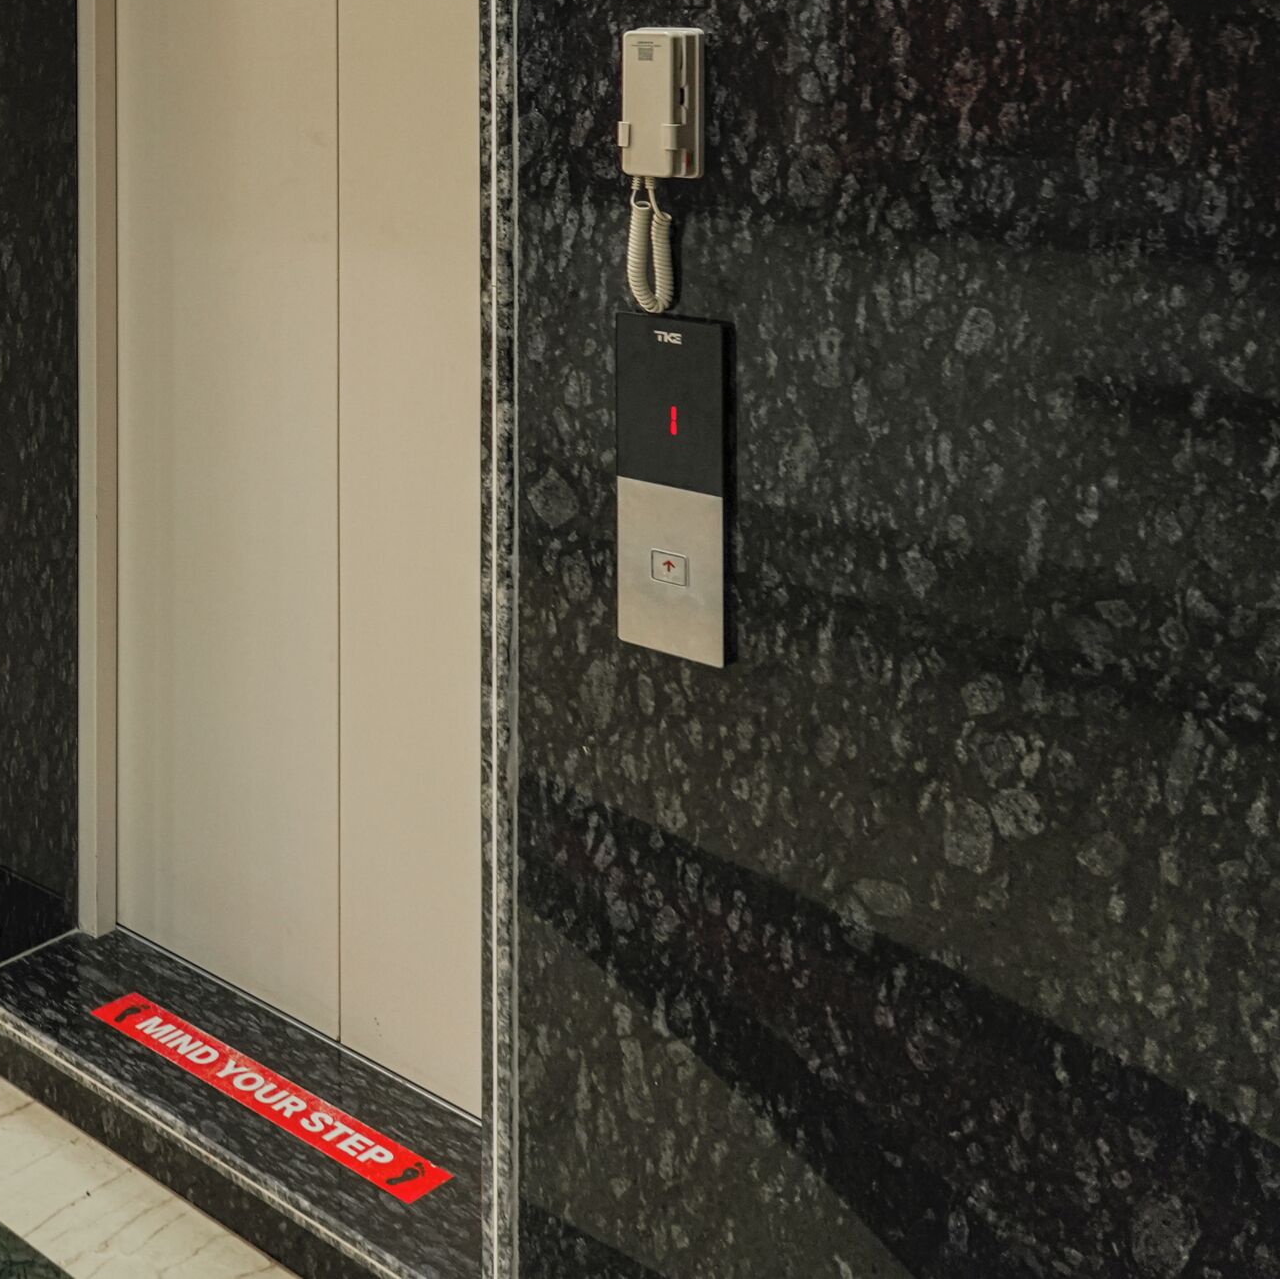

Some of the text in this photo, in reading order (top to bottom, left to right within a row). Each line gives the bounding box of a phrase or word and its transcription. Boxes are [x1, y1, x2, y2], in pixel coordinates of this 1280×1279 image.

[653, 329, 683, 345] TKE
[670, 405, 678, 435] 1
[135, 1016, 393, 1164] MIND YOUR STEP
